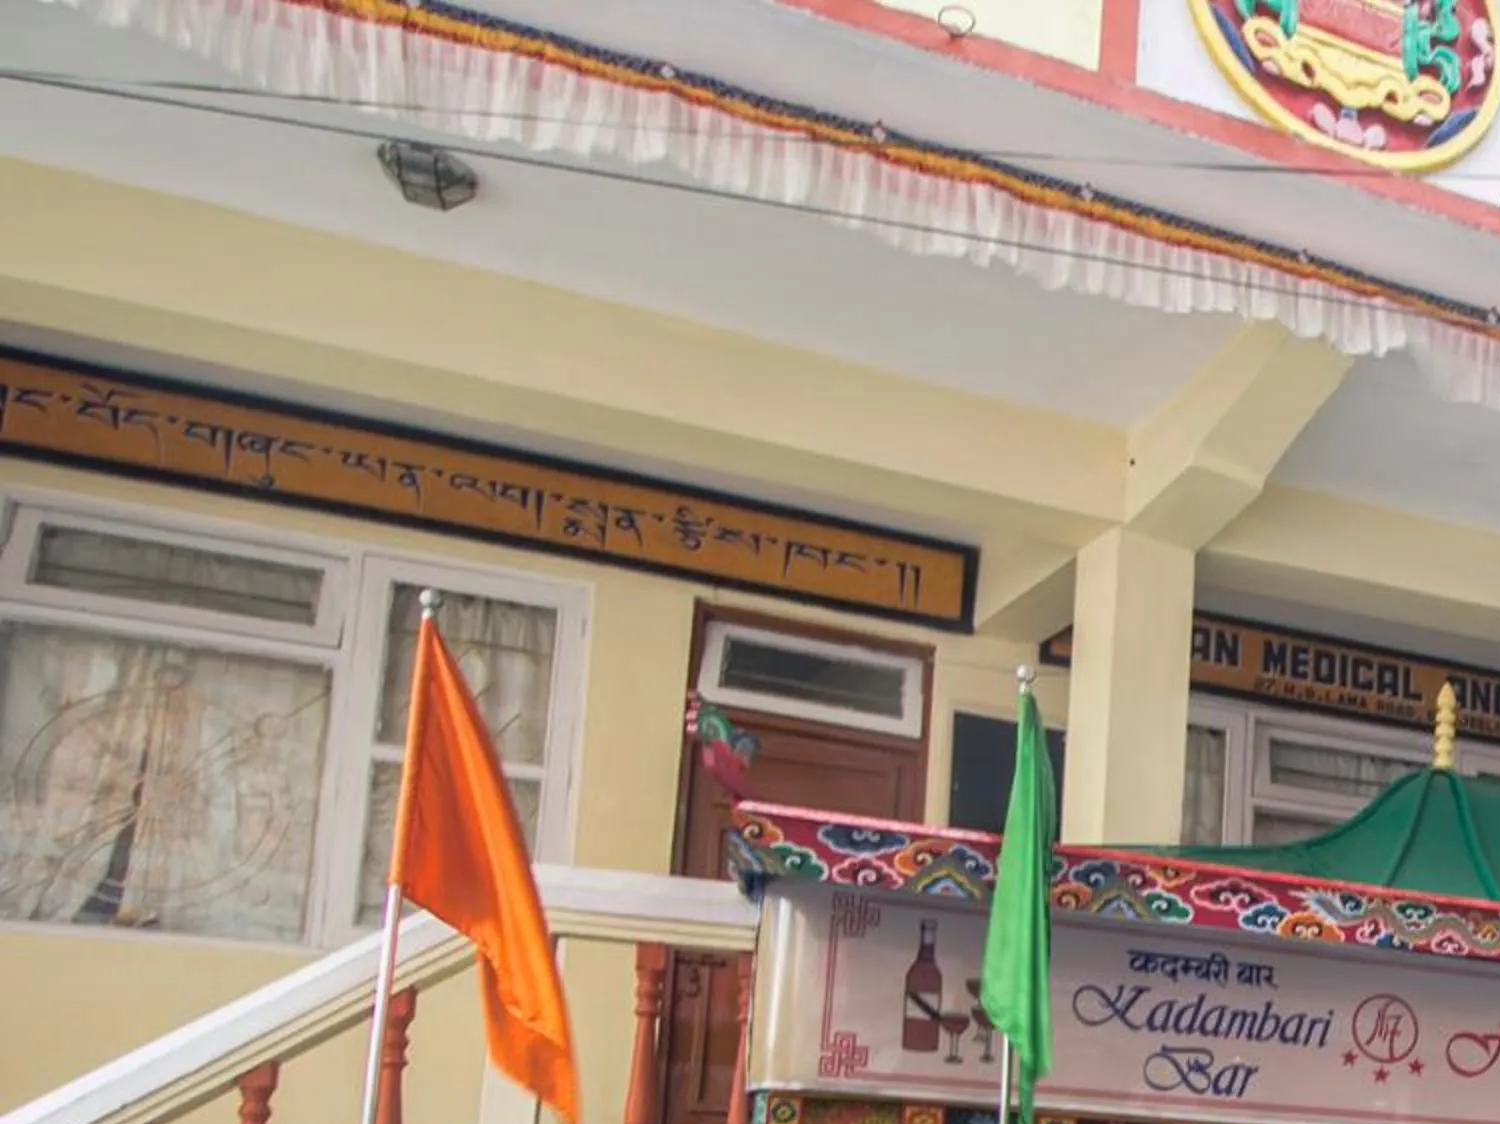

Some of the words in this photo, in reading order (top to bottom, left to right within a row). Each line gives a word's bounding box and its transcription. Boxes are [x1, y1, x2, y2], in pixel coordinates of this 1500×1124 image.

[1262, 640, 1422, 701] MEDICAL
[1073, 984, 1334, 1049] Kadambari
[1143, 1044, 1259, 1098] Bar
